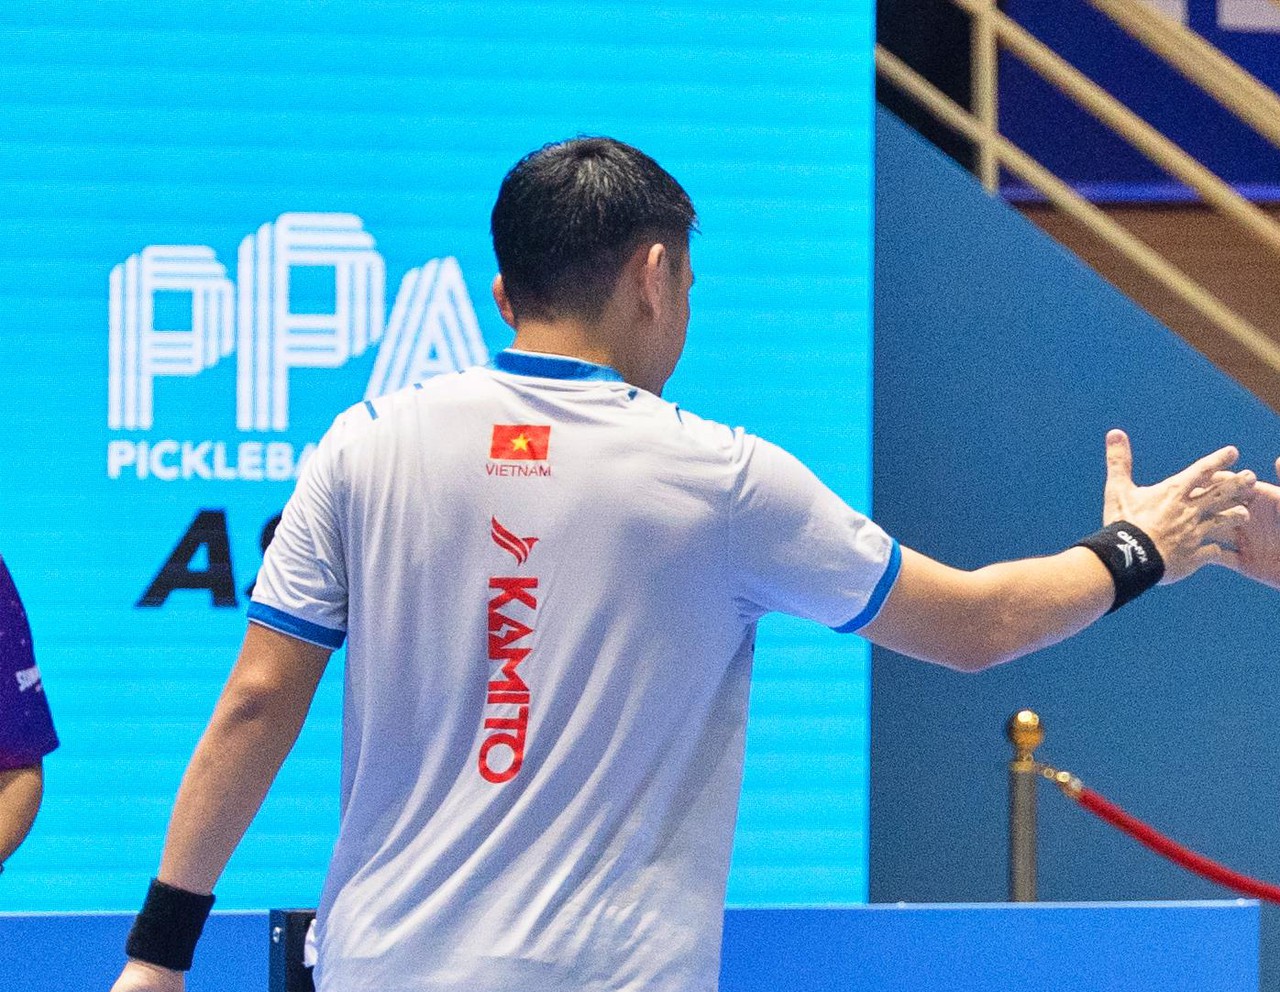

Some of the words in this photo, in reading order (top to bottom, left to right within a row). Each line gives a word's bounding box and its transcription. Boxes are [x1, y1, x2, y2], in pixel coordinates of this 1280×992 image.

[107, 211, 491, 432] PPA
[485, 463, 551, 477] VIETNAM
[478, 576, 539, 784] KAMITO
